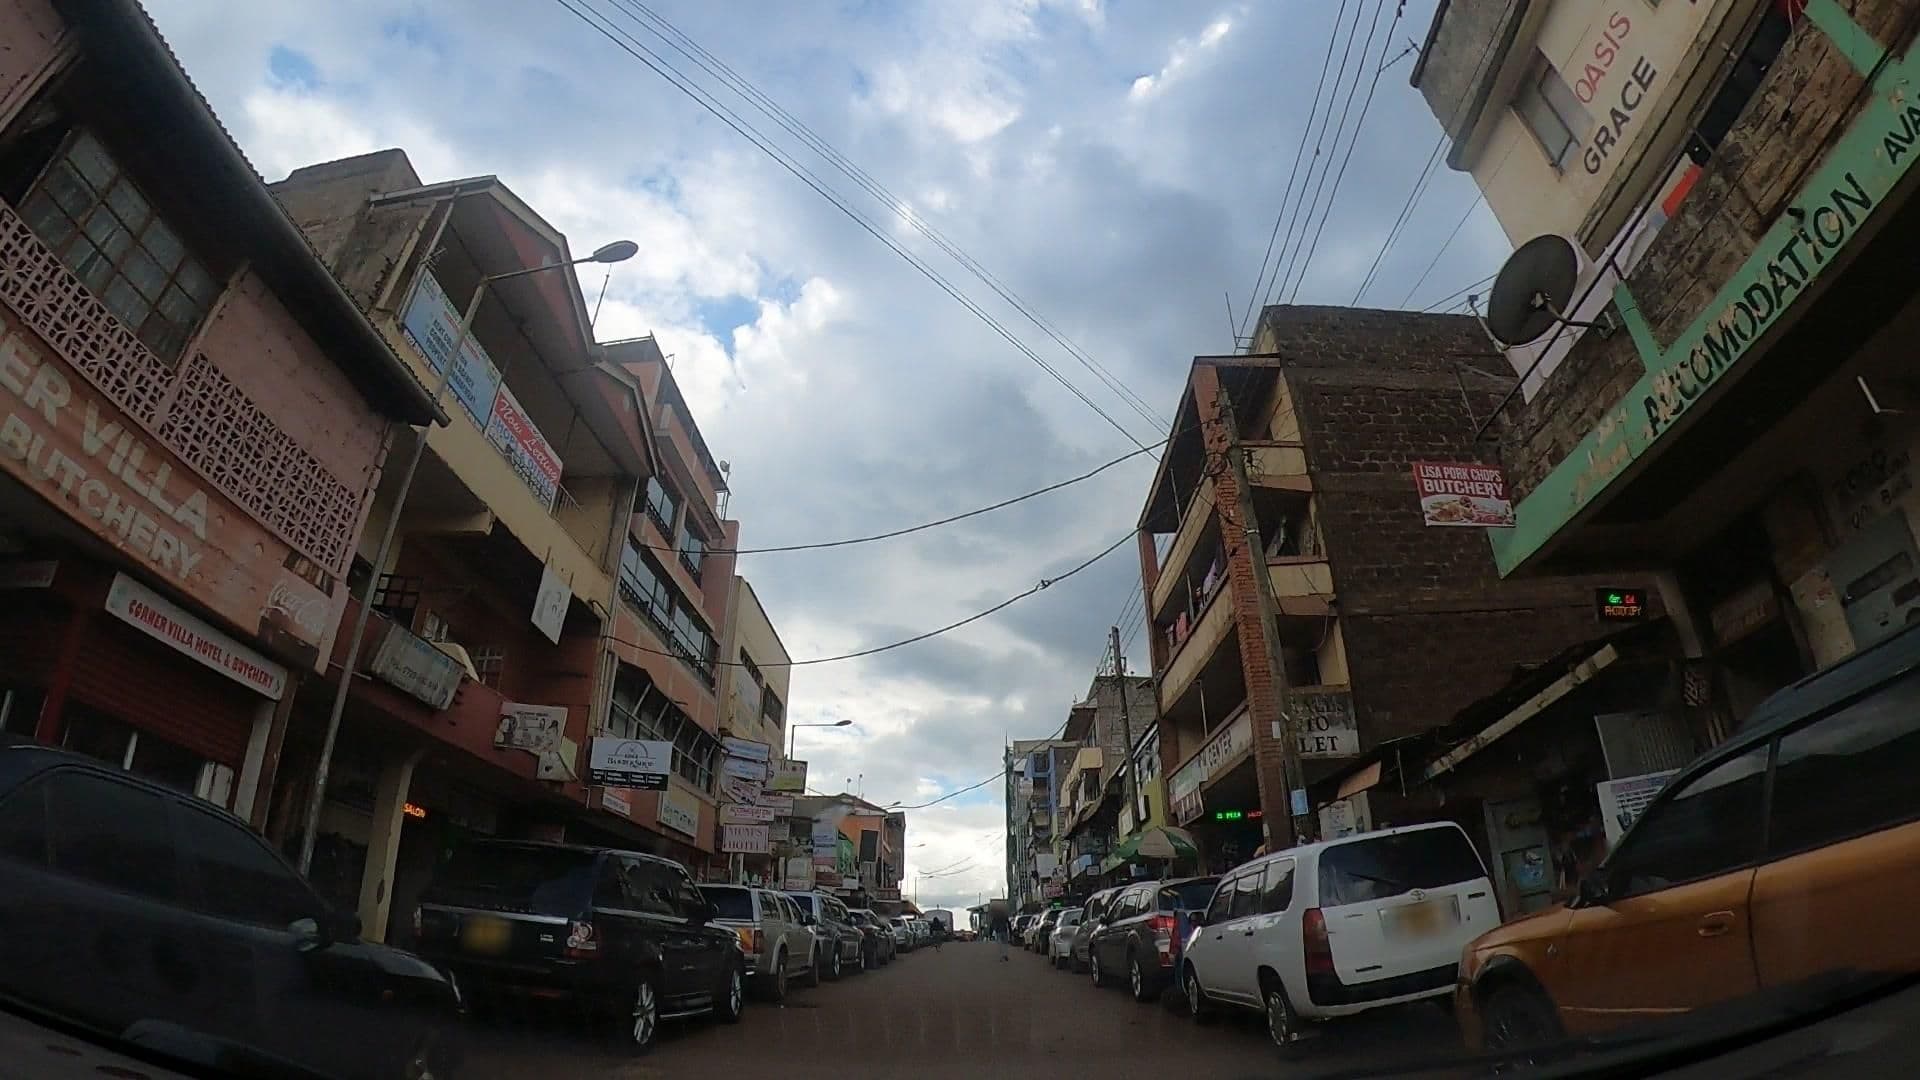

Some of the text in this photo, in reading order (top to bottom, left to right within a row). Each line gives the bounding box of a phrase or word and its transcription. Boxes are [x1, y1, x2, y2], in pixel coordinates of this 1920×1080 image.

[1575, 11, 1632, 104] OASIS
[1583, 55, 1658, 176] GRACE
[1883, 106, 1920, 165] AVA
[498, 397, 523, 438] Now
[0, 413, 202, 580] BUTCHERY
[81, 397, 209, 540] VILLA
[1419, 464, 1502, 483] LISA PORK CHOPS
[1423, 479, 1504, 497] BUTCHERY
[128, 600, 275, 690] CORNER VILLA HOTEL & BUTCHERY
[1299, 734, 1340, 754] LET
